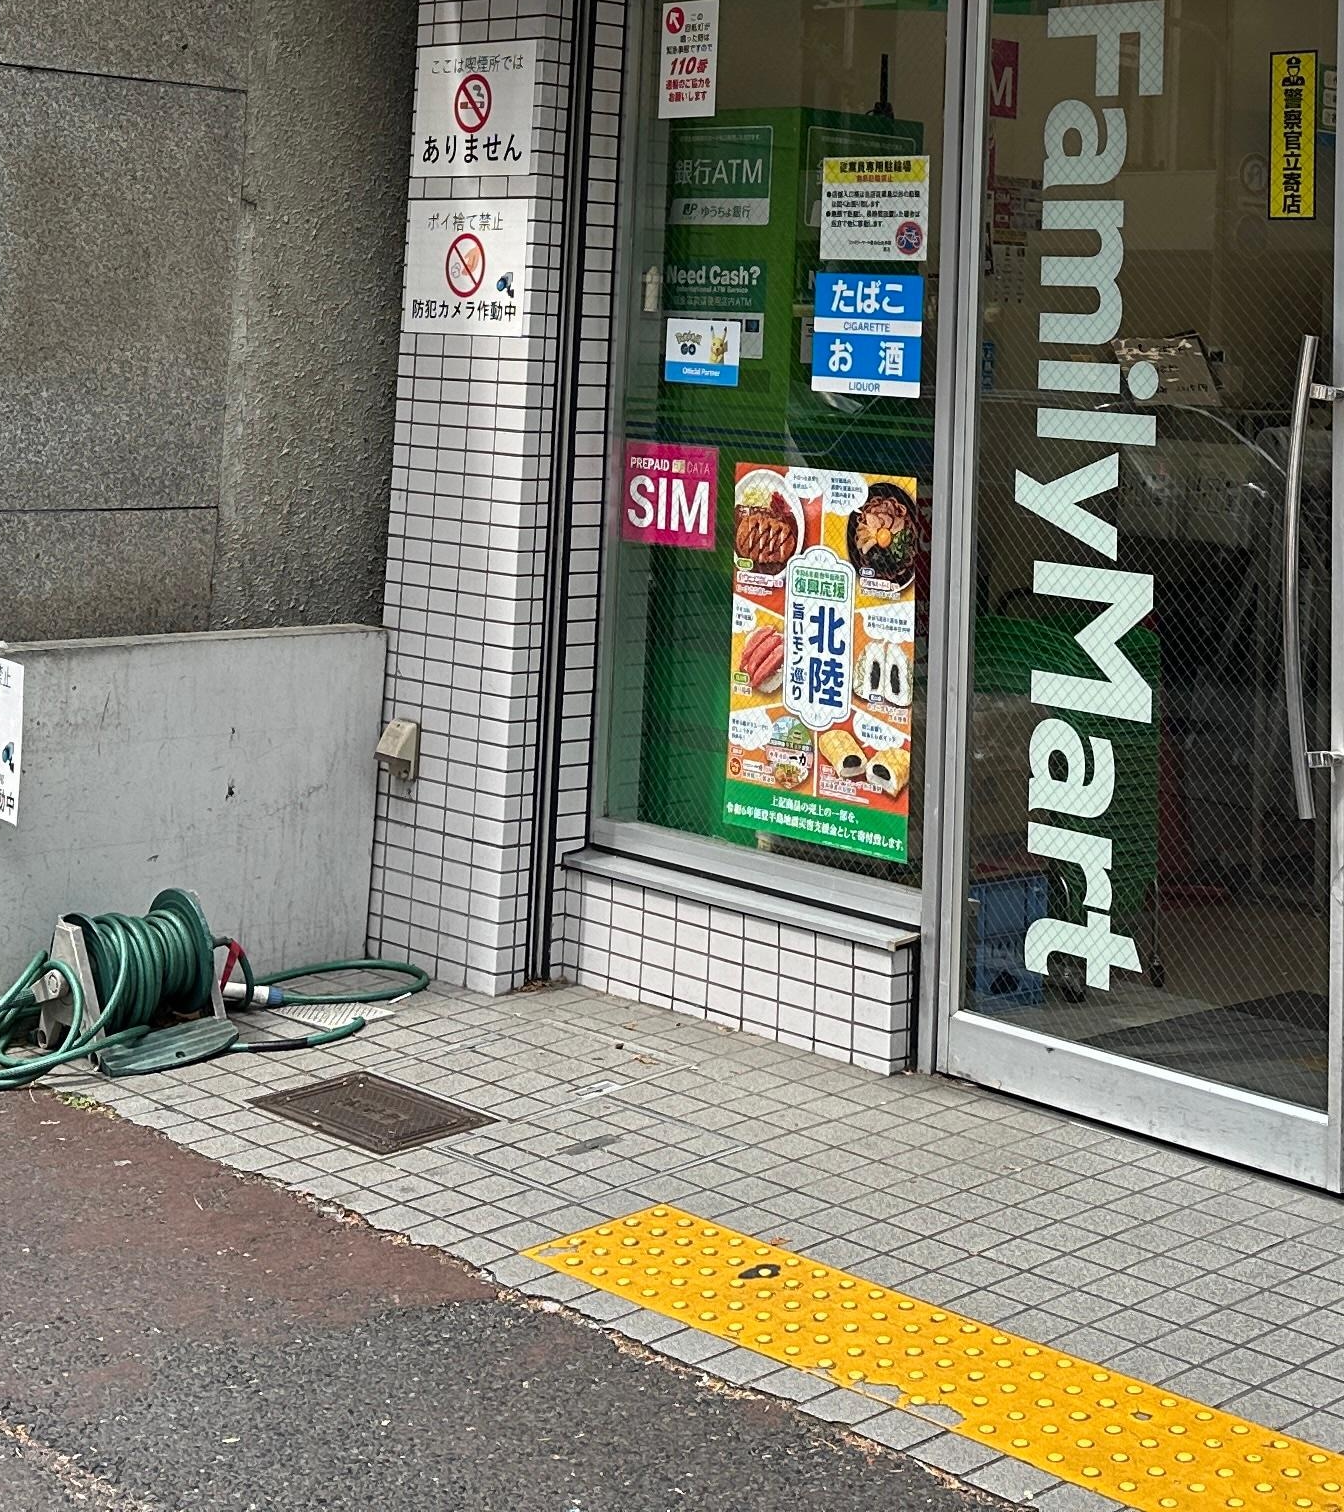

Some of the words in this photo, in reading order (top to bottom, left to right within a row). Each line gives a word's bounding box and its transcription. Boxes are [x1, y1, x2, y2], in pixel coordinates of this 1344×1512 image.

[690, 12, 704, 21] この
[431, 53, 524, 74] ここは喫煙所では
[669, 56, 709, 76] 110番
[668, 90, 708, 103] お願いします
[422, 133, 522, 164] ありません
[1280, 88, 1304, 215] 警察官立寄店
[674, 158, 763, 185] 銀行ATM
[700, 204, 751, 219] ゆうちょ銀行
[427, 212, 504, 232] ポイ捨て禁止
[667, 265, 706, 285] Need
[709, 265, 761, 285] Cash?
[830, 279, 905, 314] たばこ
[411, 299, 517, 321] 防犯カメラ作動中
[843, 321, 891, 333] CIGARETTE
[681, 343, 696, 355] GO
[682, 367, 701, 375] Official
[701, 368, 721, 377] Partner
[848, 382, 881, 392] LIQUOR
[630, 456, 670, 472] PREPAID
[627, 474, 710, 535] SIM
[1014, 0, 1166, 991] FamilyMart
[794, 577, 846, 600] 復興応援
[790, 601, 806, 701] 旨いモン巡り
[809, 605, 846, 708] 北陸
